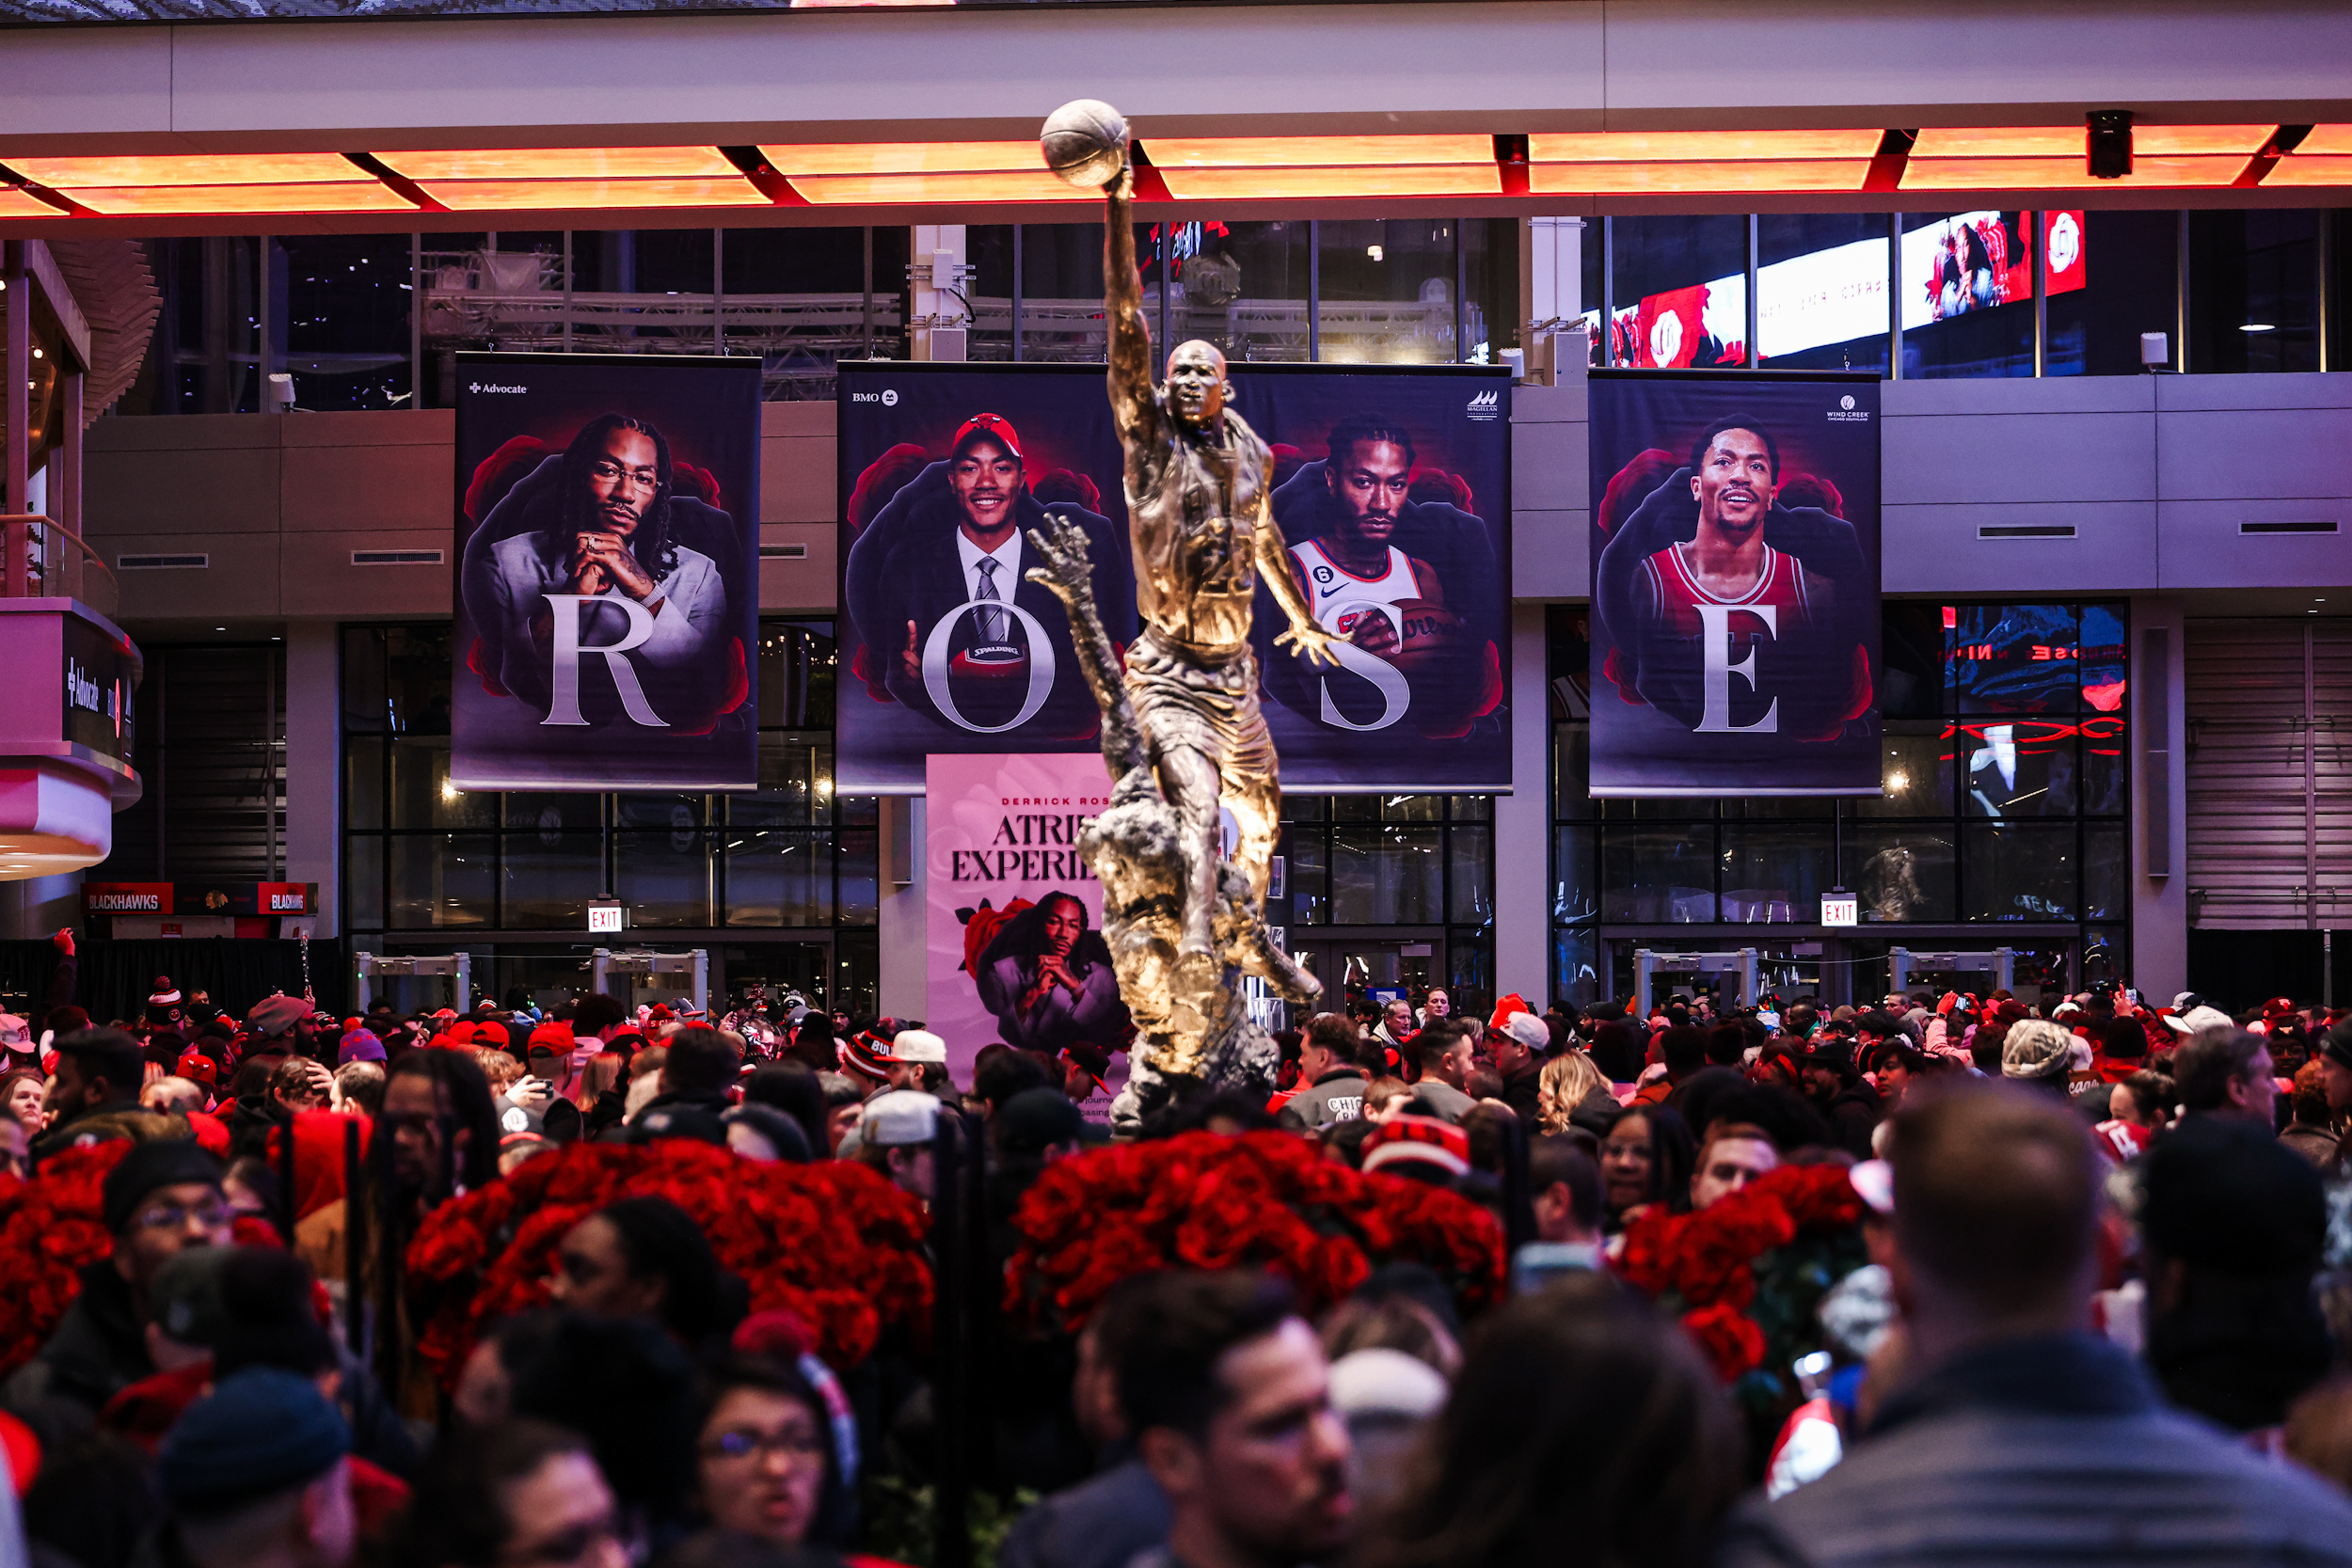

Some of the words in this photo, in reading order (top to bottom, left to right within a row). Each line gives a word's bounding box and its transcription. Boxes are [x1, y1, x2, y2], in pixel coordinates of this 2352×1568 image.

[483, 384, 527, 393] Advocate
[852, 393, 879, 402] BMO
[1317, 565, 1330, 581] 6
[975, 646, 1020, 657] SPALDING
[540, 594, 671, 726] R
[922, 599, 1056, 733] O
[1321, 599, 1410, 731] S
[1692, 605, 1777, 732] E
[88, 895, 159, 911] BLACKHAWKS
[593, 911, 616, 927] EXIT
[1826, 905, 1852, 921] EXIT
[871, 1039, 893, 1056] BUL
[1327, 1096, 1363, 1112] CHIC
